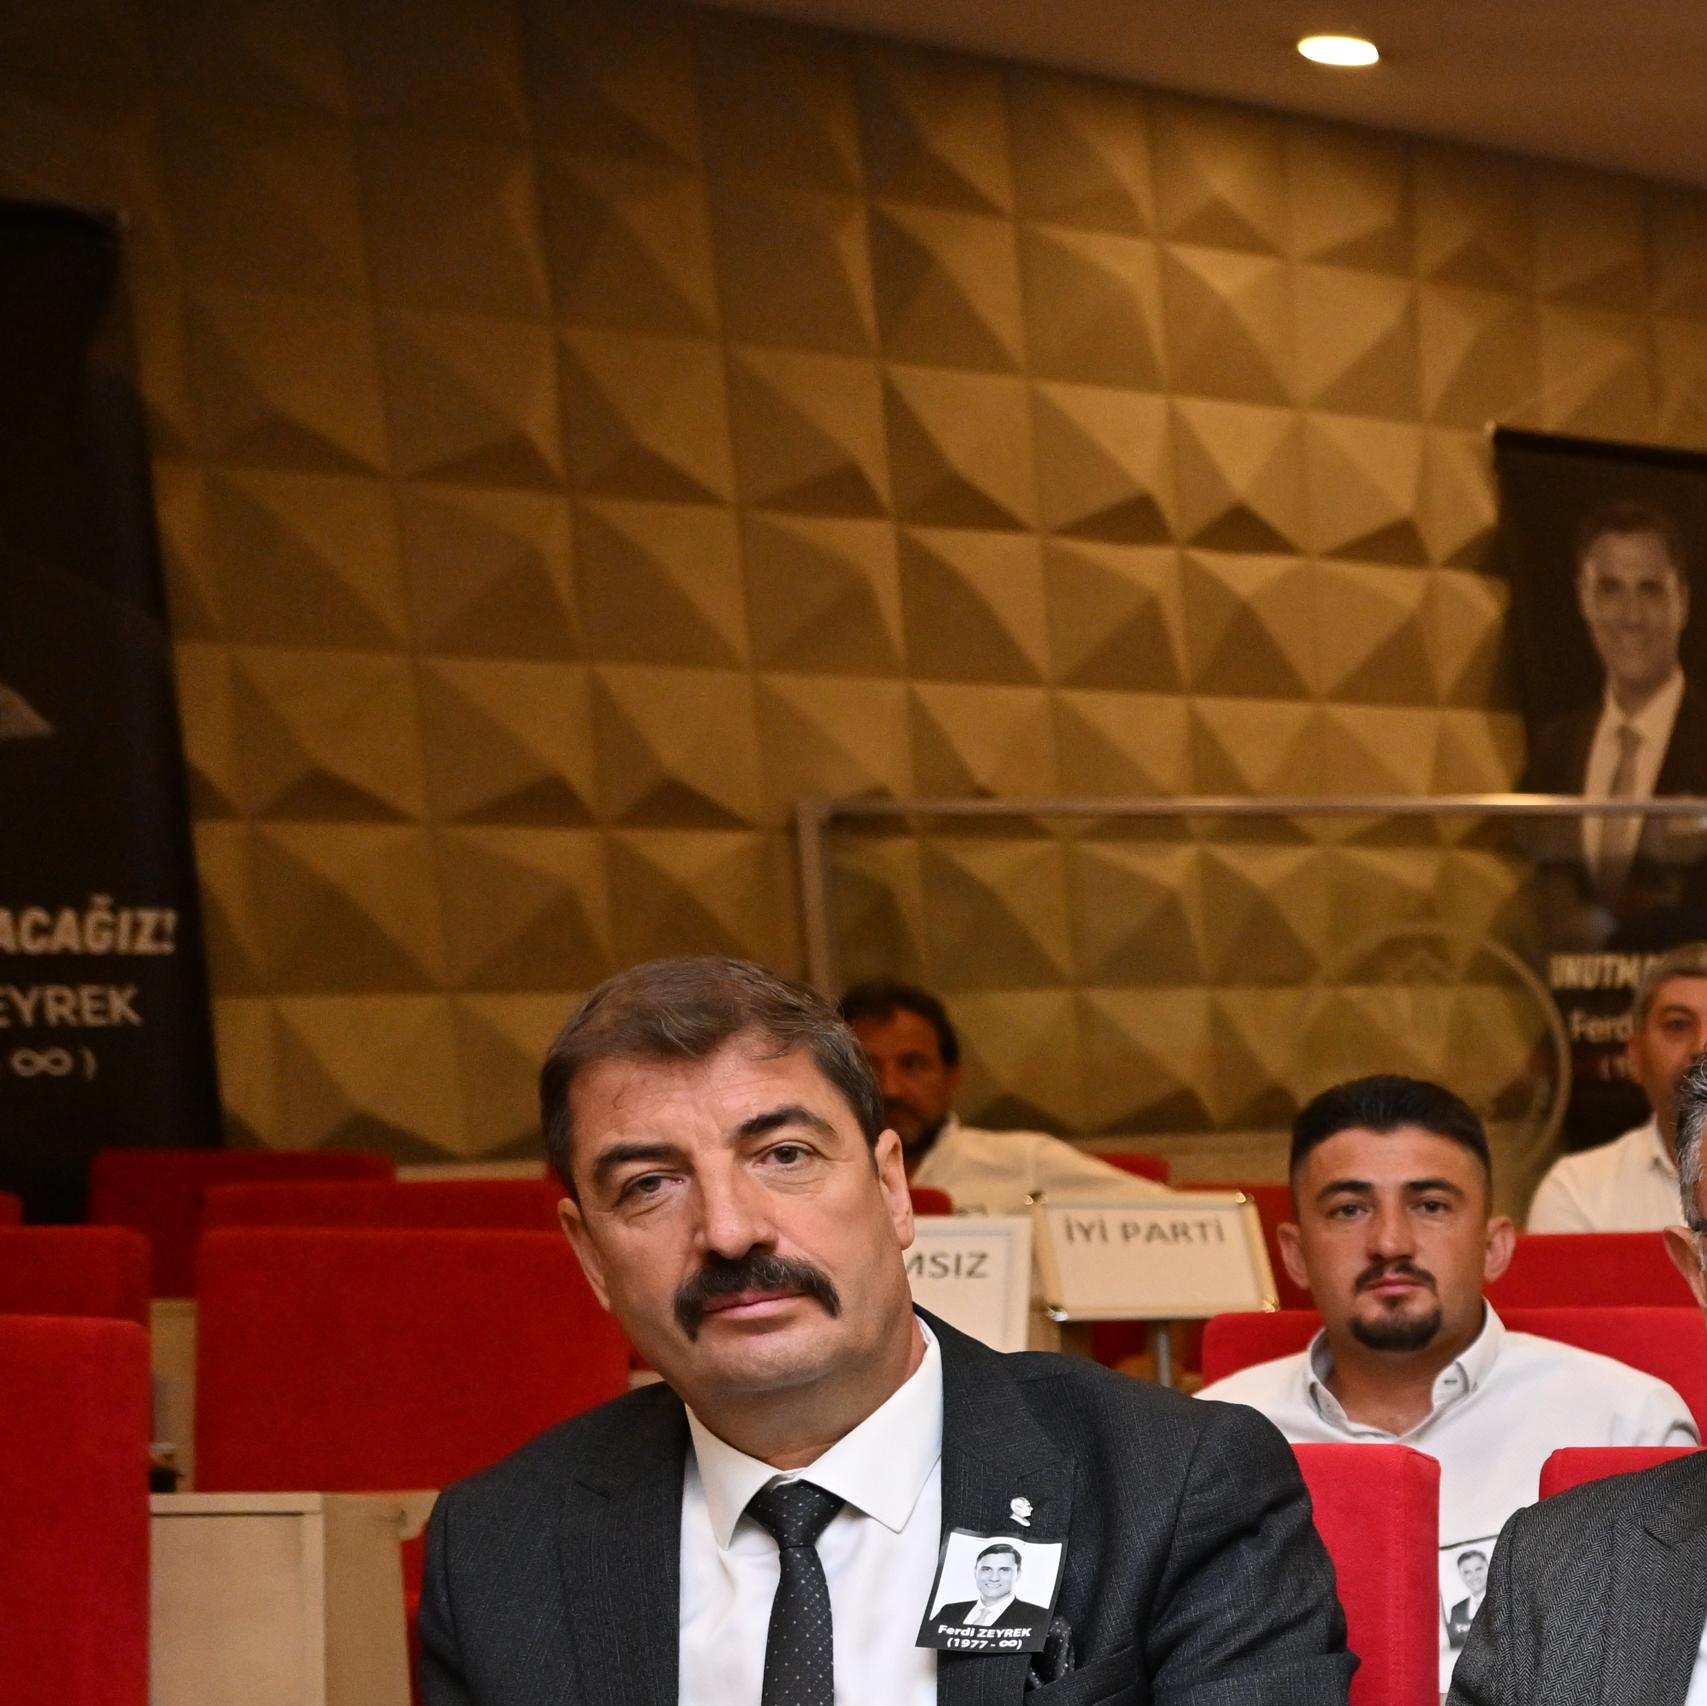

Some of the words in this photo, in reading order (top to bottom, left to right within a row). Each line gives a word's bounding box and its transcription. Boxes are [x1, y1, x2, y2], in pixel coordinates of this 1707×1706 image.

[1064, 1216, 1109, 1245] İYİ
[1120, 1217, 1226, 1245] PARTİ
[937, 1624, 976, 1637] Ferdi
[976, 1627, 1033, 1638] ZEYREK
